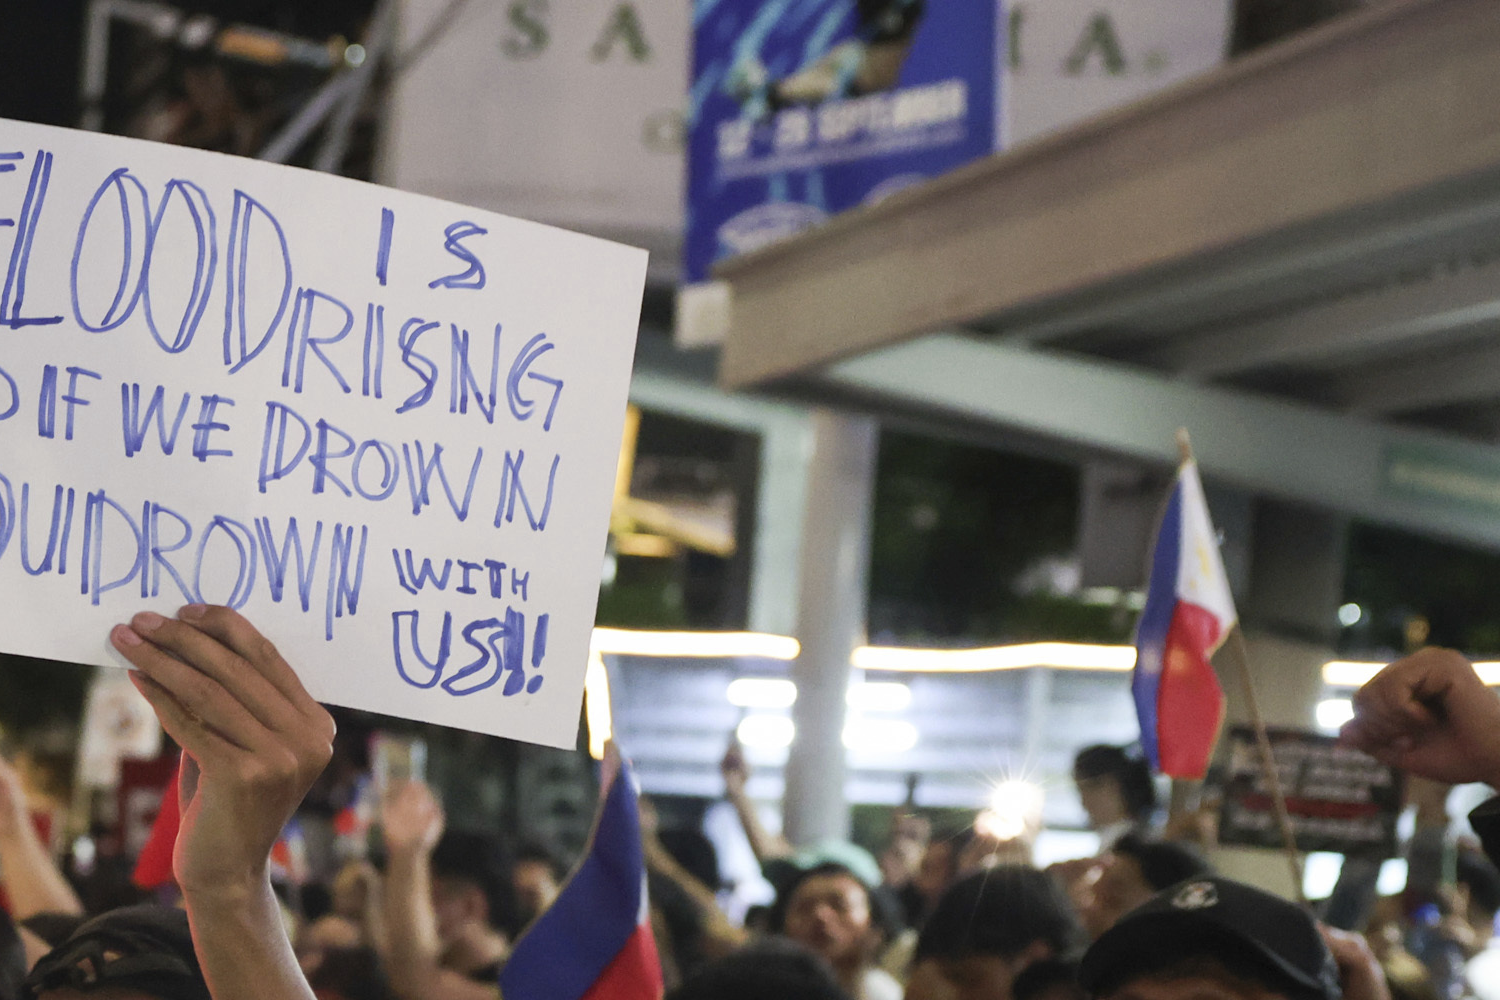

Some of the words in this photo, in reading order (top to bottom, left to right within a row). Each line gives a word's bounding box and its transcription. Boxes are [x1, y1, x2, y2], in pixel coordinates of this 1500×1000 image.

[376, 207, 488, 290] IS
[38, 364, 102, 440] IF
[121, 382, 236, 462] WE
[258, 401, 561, 532] DROWN
[80, 488, 369, 641] DROWN
[392, 548, 530, 602] WITH
